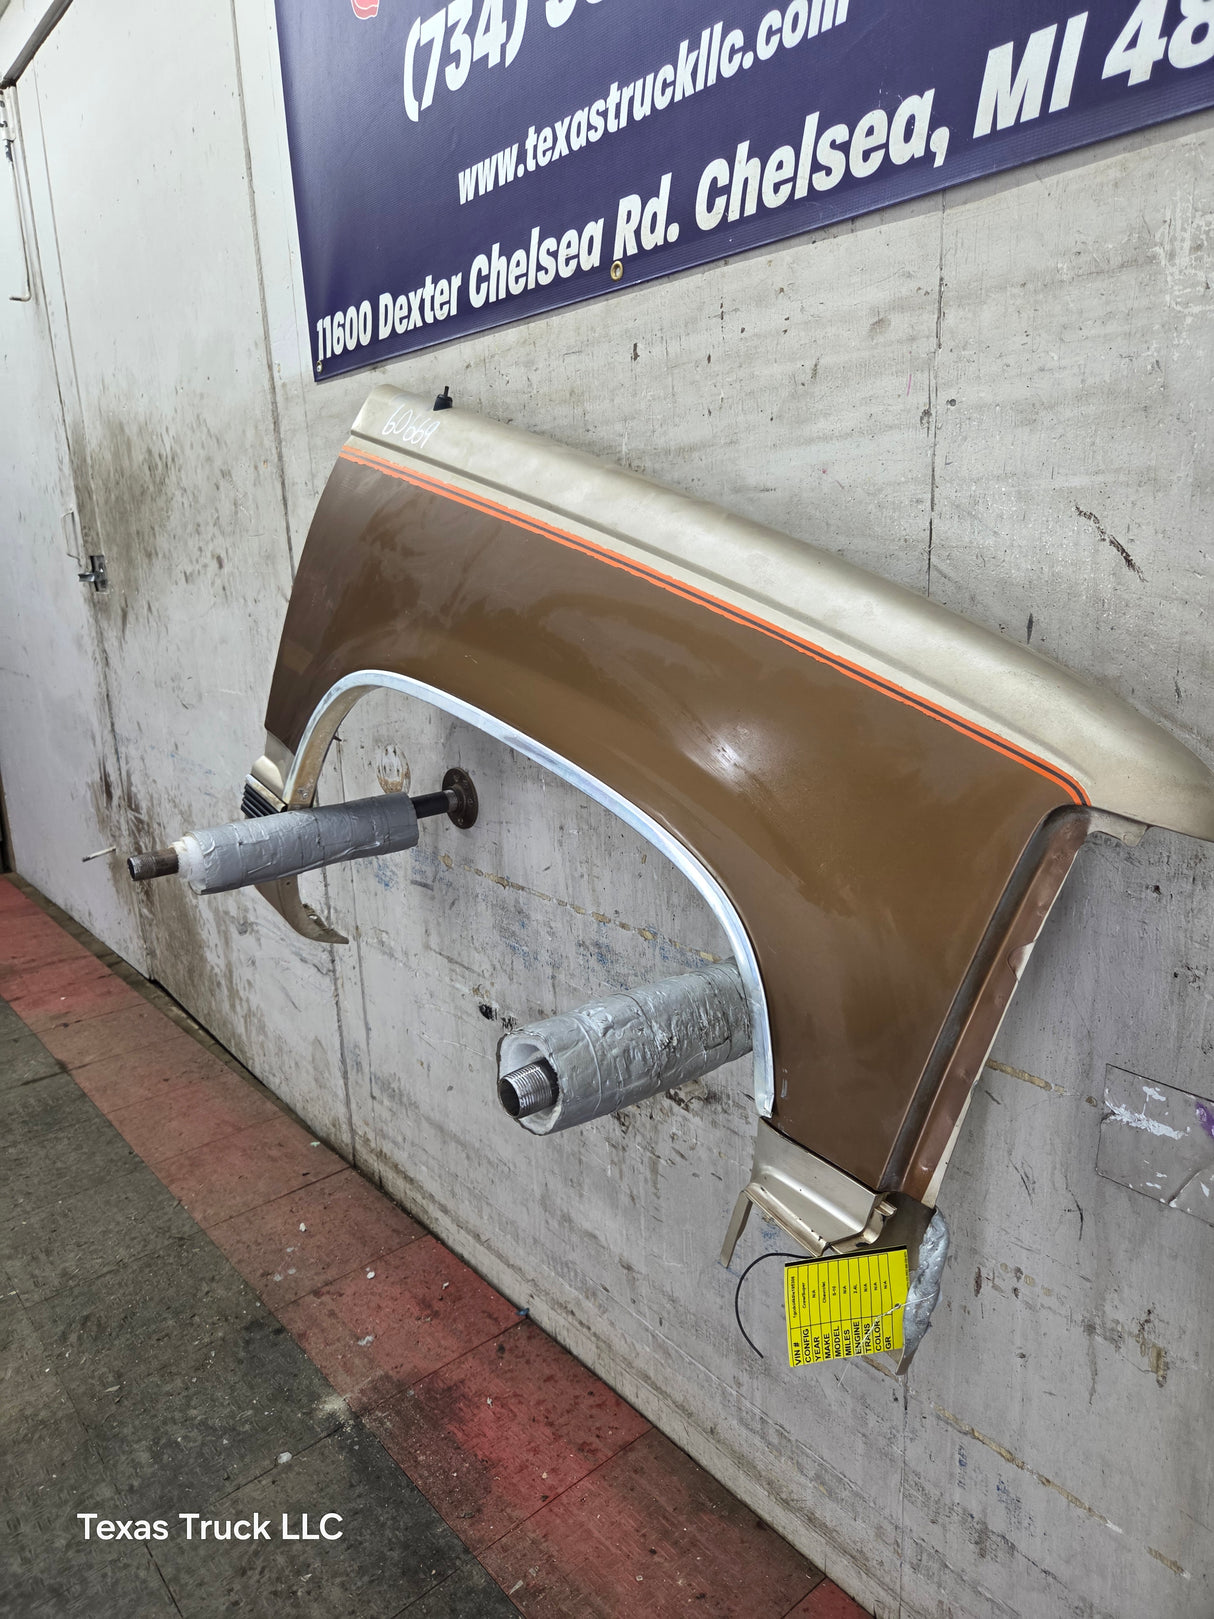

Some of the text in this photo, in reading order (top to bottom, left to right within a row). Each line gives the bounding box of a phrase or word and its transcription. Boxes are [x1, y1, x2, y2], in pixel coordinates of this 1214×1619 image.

[403, 0, 528, 122] (734)
[458, 0, 850, 205] www.texastruckllc.com
[316, 300, 373, 361] 11600
[378, 274, 462, 341] Dexter
[469, 217, 604, 308] Chelsea
[613, 172, 680, 261] Rd.
[695, 88, 950, 231] Chelsea,
[972, 11, 1089, 139] MI
[802, 1328, 811, 1363] CONFIG
[813, 1336, 821, 1362] YEAR
[823, 1333, 831, 1359] MAKE
[833, 1326, 841, 1357] MODEL
[843, 1329, 852, 1356] MILES
[853, 1321, 862, 1354] ENGINE
[863, 1323, 872, 1353] TRANS
[873, 1320, 882, 1352] COLOR
[885, 1336, 892, 1350] GR
[794, 1349, 802, 1366] VIN
